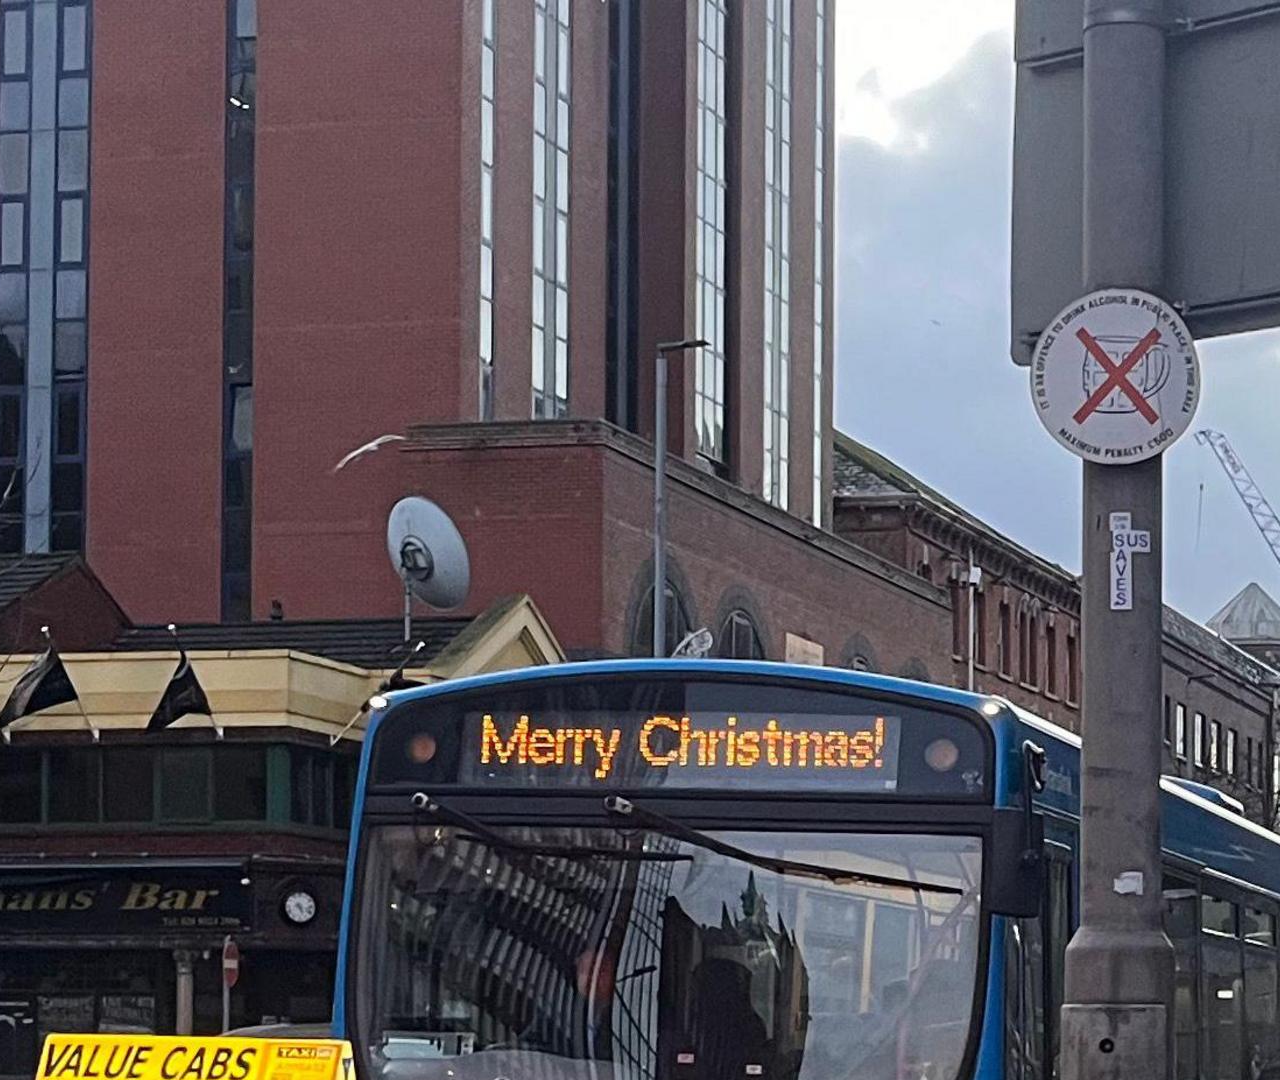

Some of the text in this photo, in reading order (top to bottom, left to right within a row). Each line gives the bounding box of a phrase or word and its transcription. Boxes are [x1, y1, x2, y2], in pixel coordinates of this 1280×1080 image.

[1058, 427, 1101, 456] MAXIMUM
[1104, 445, 1144, 458] PENALTY
[480, 714, 884, 779] Merry Christmas!
[120, 881, 220, 911] Bar
[42, 1043, 154, 1079] VALUE
[279, 1047, 317, 1058] TAXI
